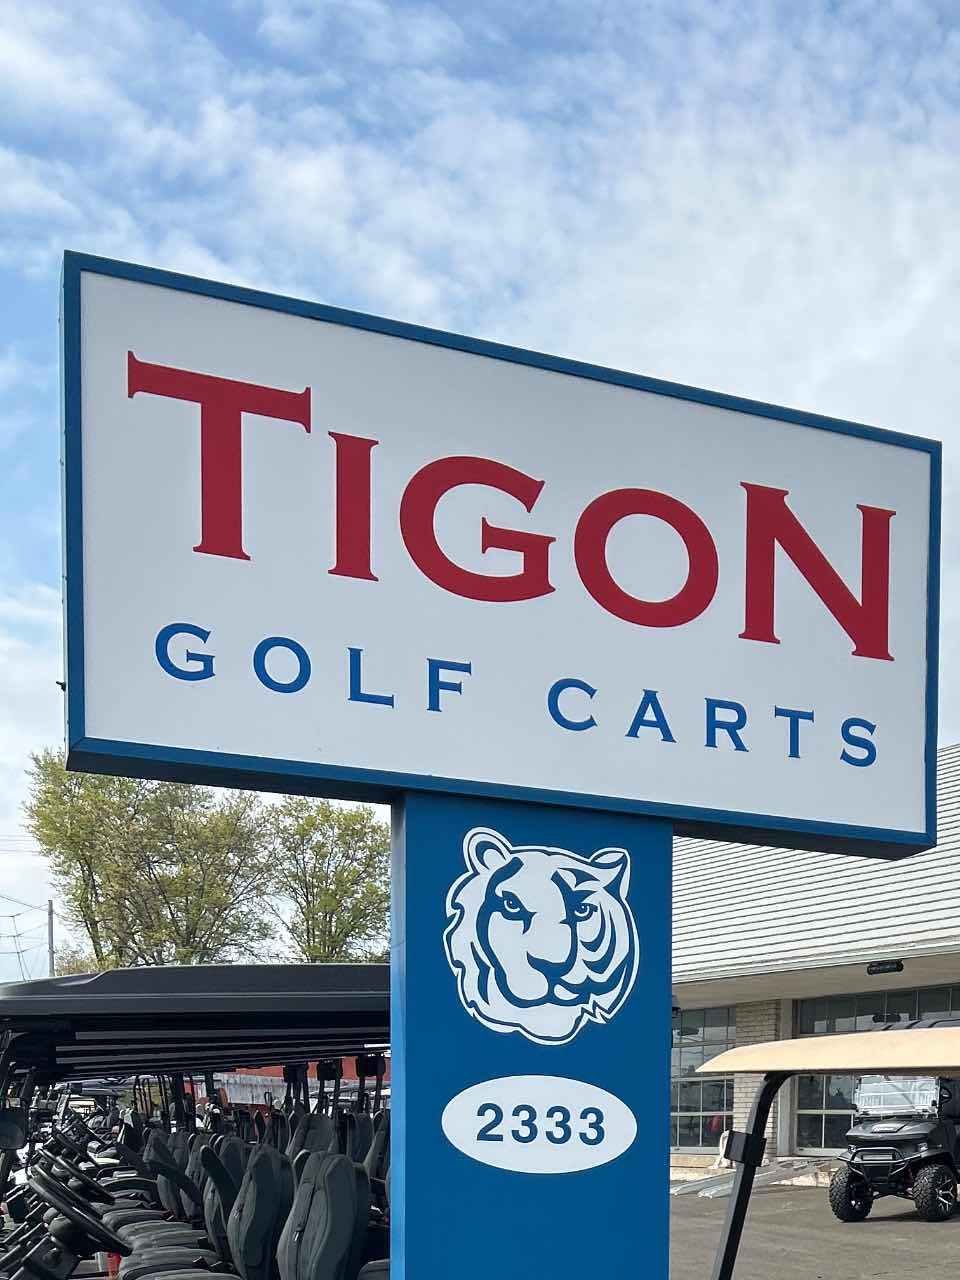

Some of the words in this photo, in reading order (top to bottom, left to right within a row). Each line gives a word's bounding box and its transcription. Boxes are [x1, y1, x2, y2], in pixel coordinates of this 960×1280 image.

[127, 350, 896, 661] TIGON
[154, 623, 475, 715] GOLF
[546, 677, 878, 769] CARTS
[476, 1102, 606, 1146] 2333
